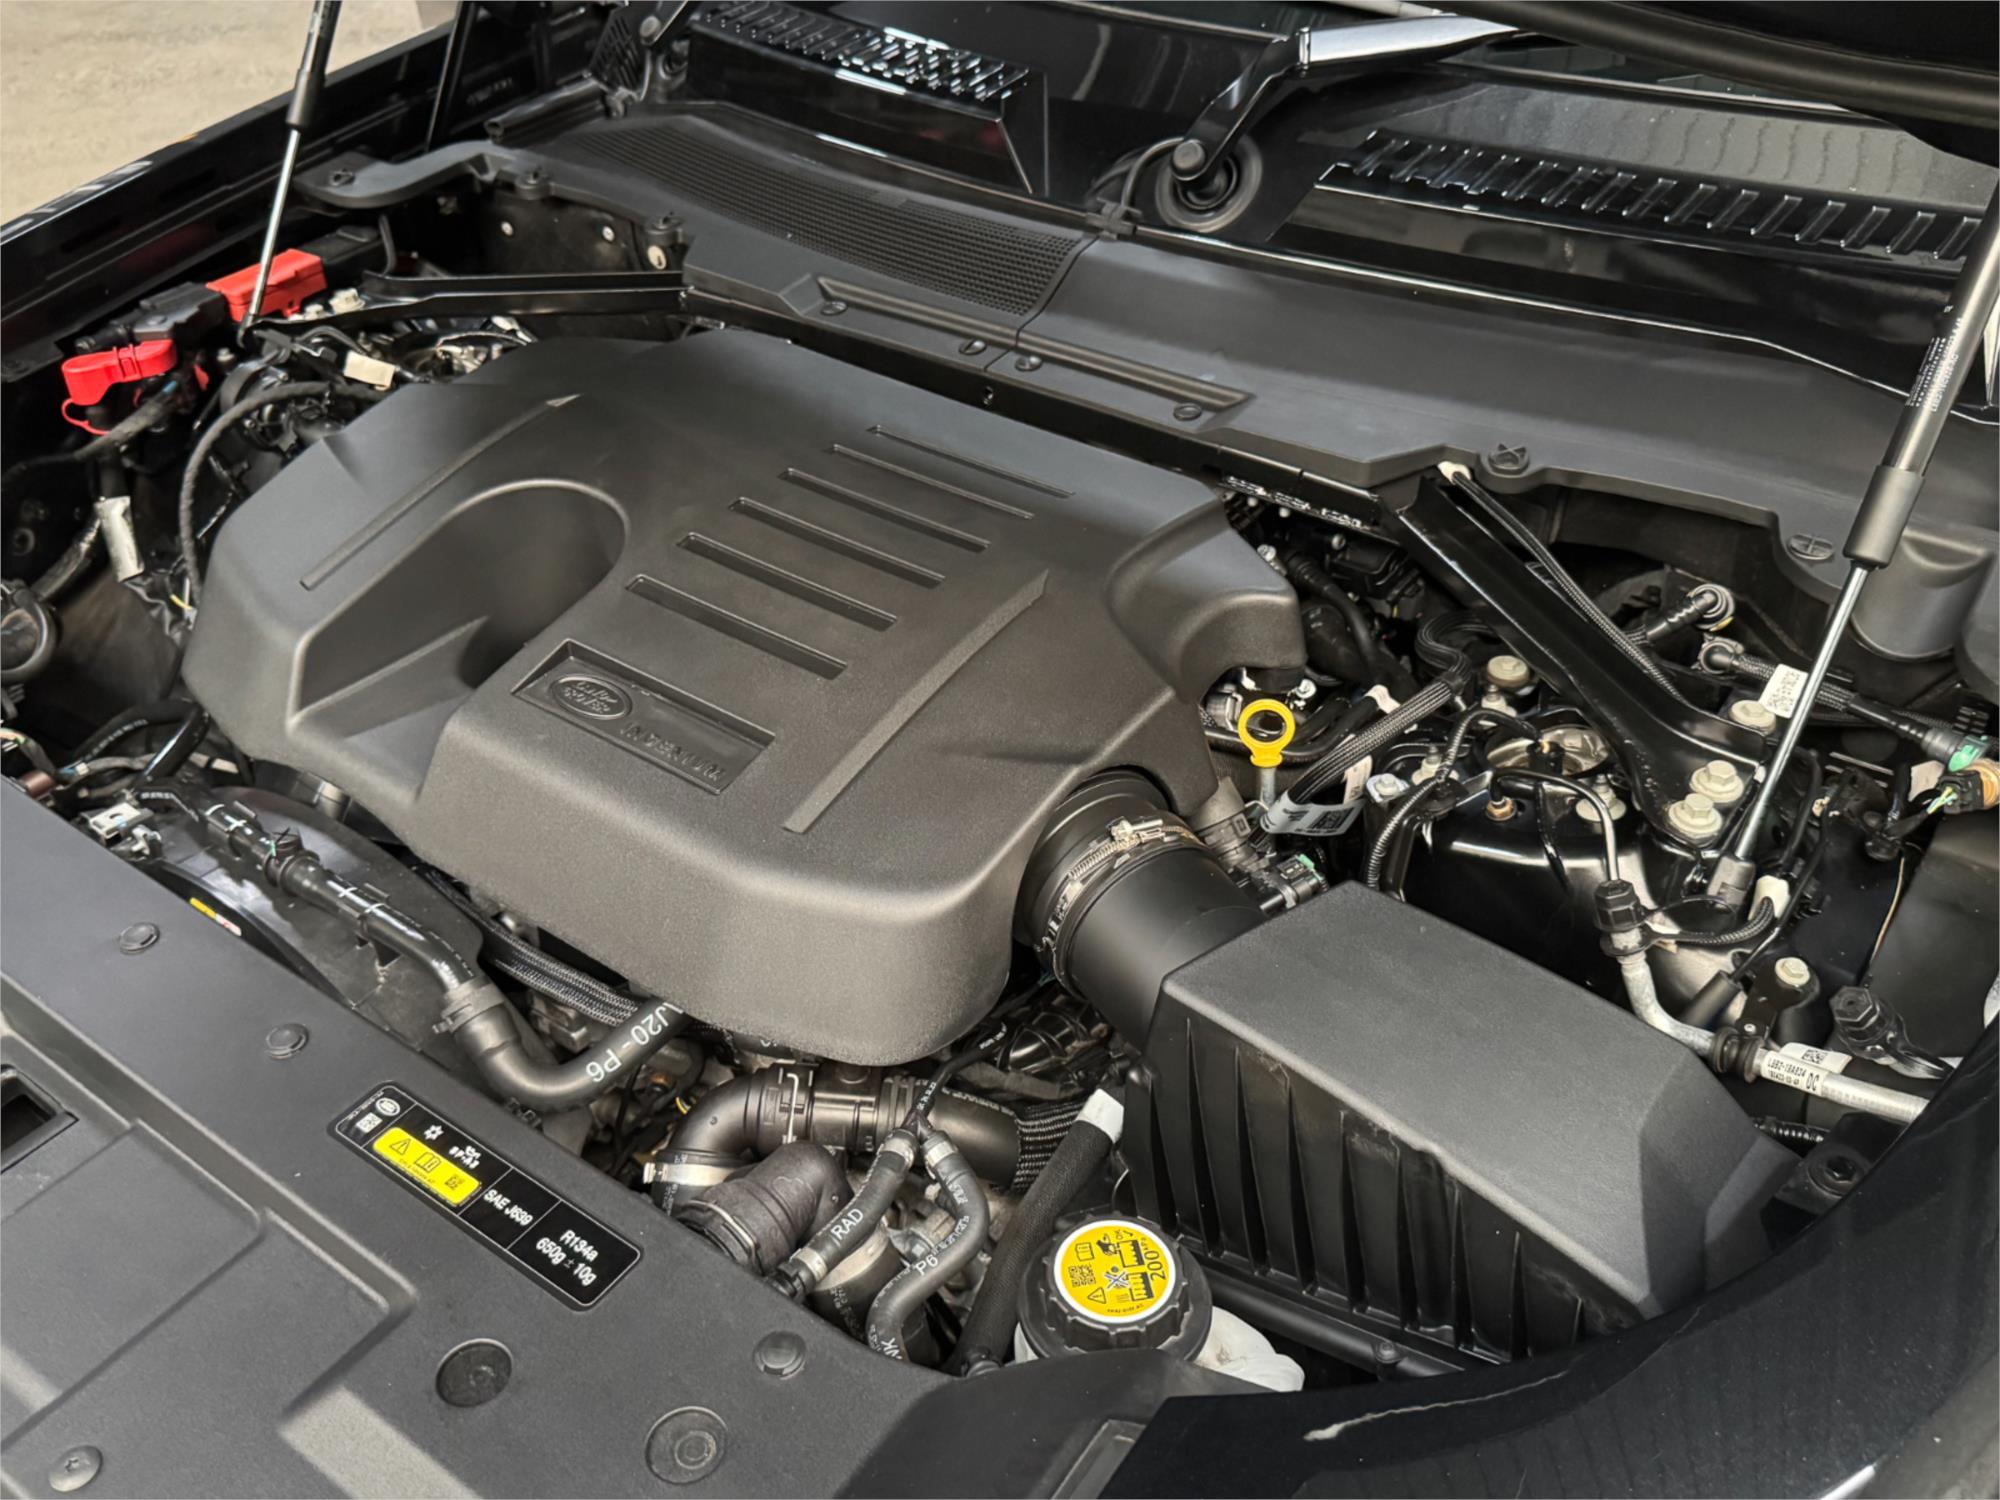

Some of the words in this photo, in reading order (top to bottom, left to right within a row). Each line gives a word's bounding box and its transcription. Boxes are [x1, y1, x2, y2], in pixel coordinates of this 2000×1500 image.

[586, 1048, 622, 1082] P6
[484, 1189, 510, 1210] SAE
[504, 1205, 533, 1226] J639
[831, 1208, 863, 1240] RAD
[536, 1237, 567, 1265] 650g
[573, 1263, 597, 1286] 10g
[560, 1229, 599, 1262] R134a
[915, 1254, 939, 1276] P6
[881, 1337, 902, 1359] NK
